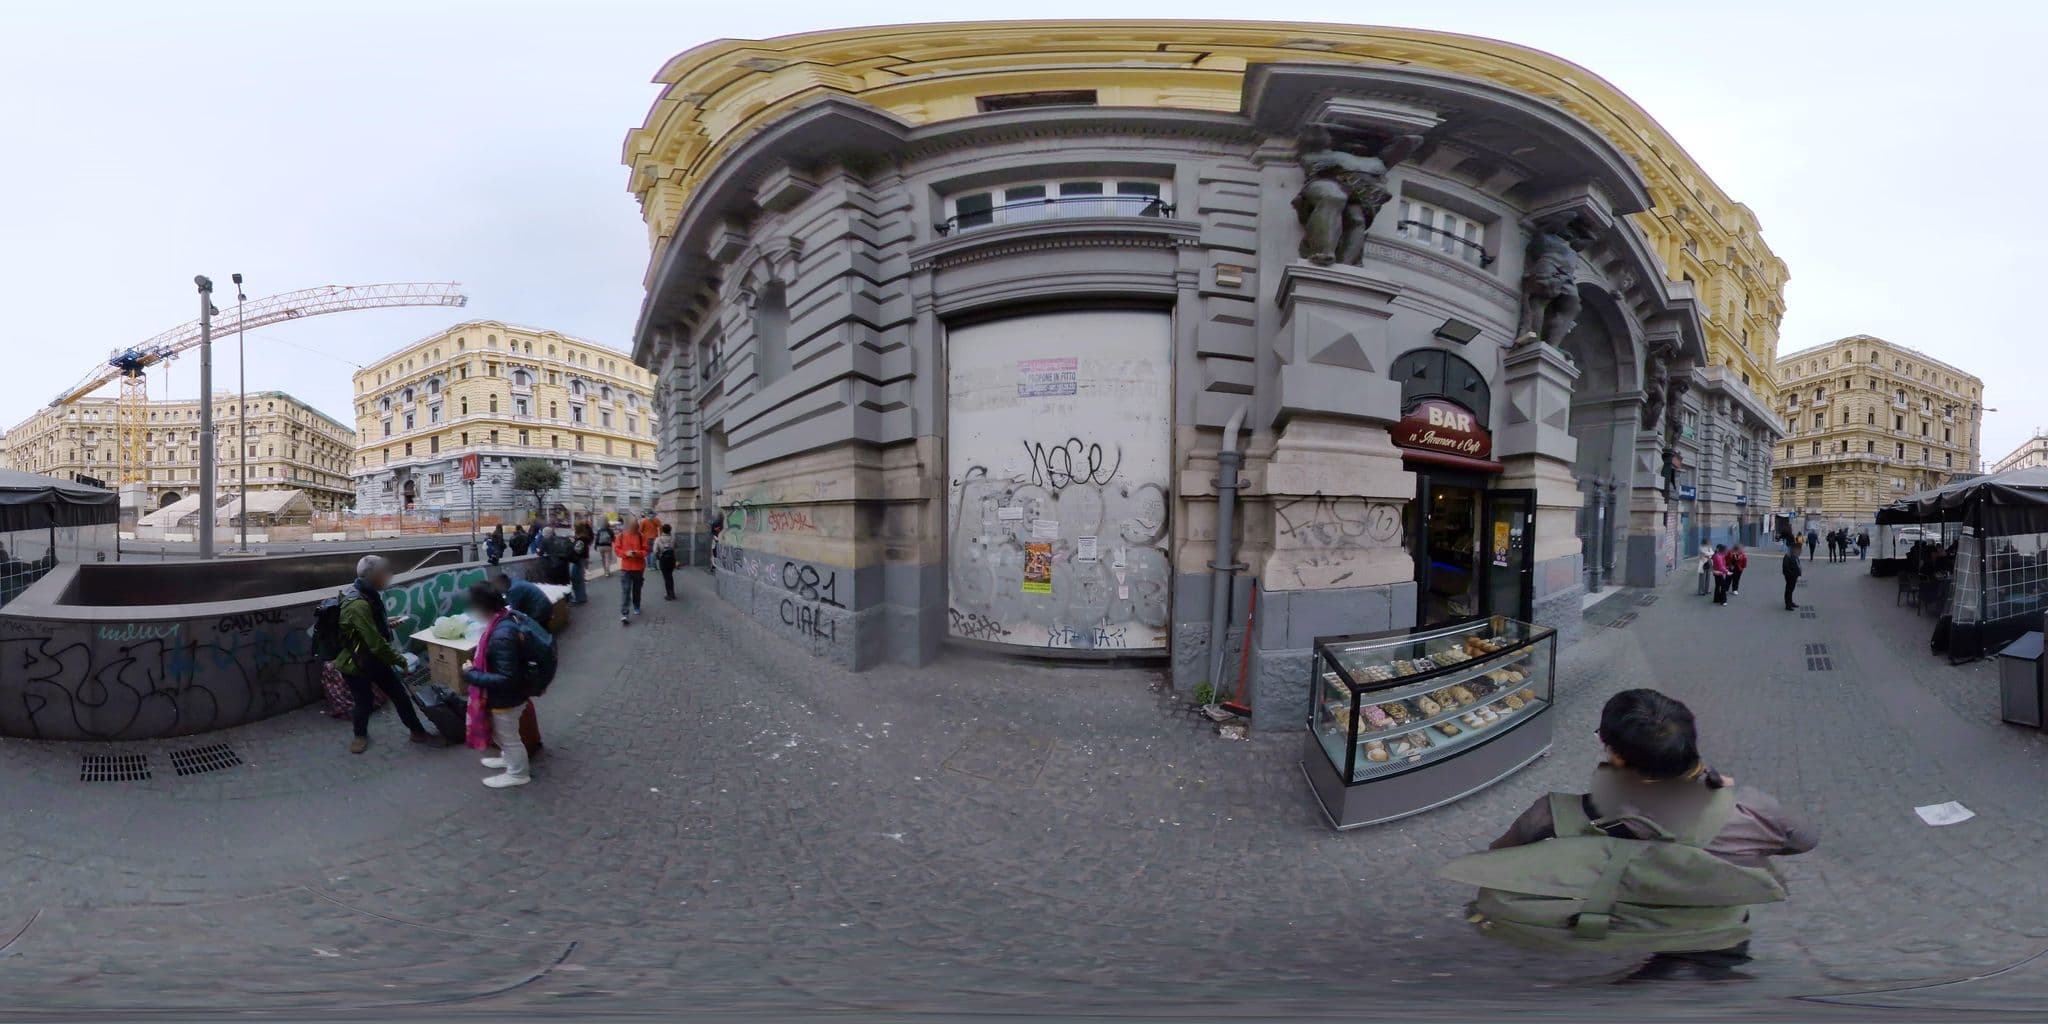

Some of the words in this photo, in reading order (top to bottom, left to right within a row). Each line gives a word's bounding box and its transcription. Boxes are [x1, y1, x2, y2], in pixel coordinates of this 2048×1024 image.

[1429, 406, 1471, 432] BAR
[464, 459, 476, 474] M
[782, 561, 846, 609] 081
